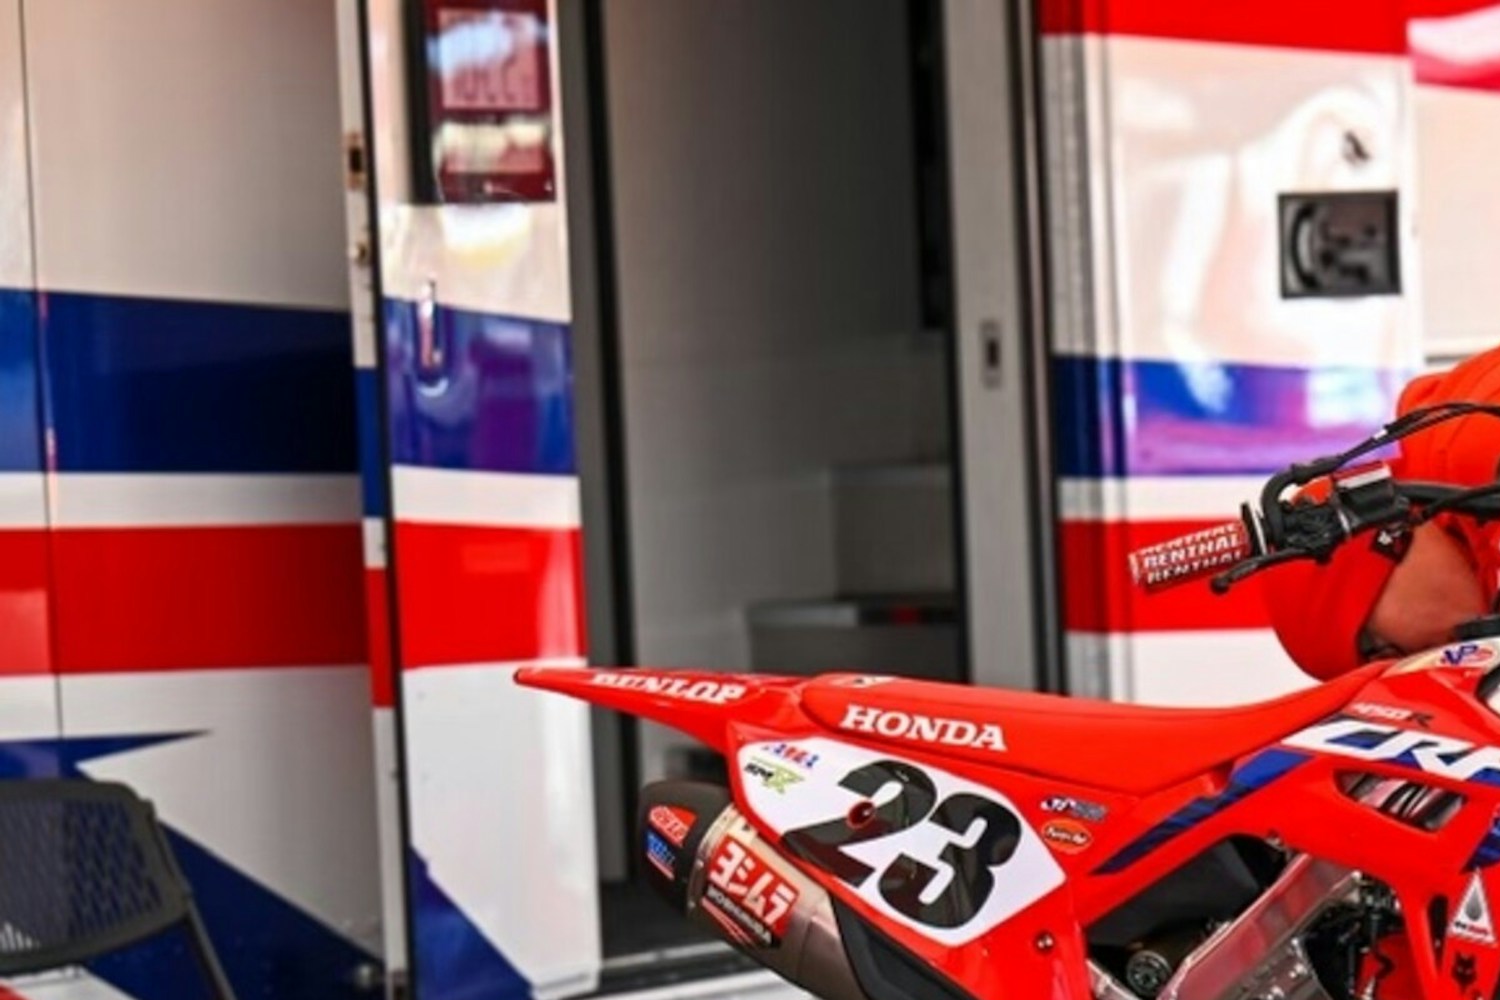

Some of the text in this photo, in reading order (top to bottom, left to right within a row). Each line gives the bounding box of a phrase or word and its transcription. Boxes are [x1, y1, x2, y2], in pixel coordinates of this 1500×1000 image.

[1143, 532, 1241, 569] RENTHAL
[591, 673, 749, 704] DUNLOP
[839, 703, 1009, 752] HONDA
[780, 758, 1023, 931] 23
[709, 840, 798, 925] ヨシムラ
